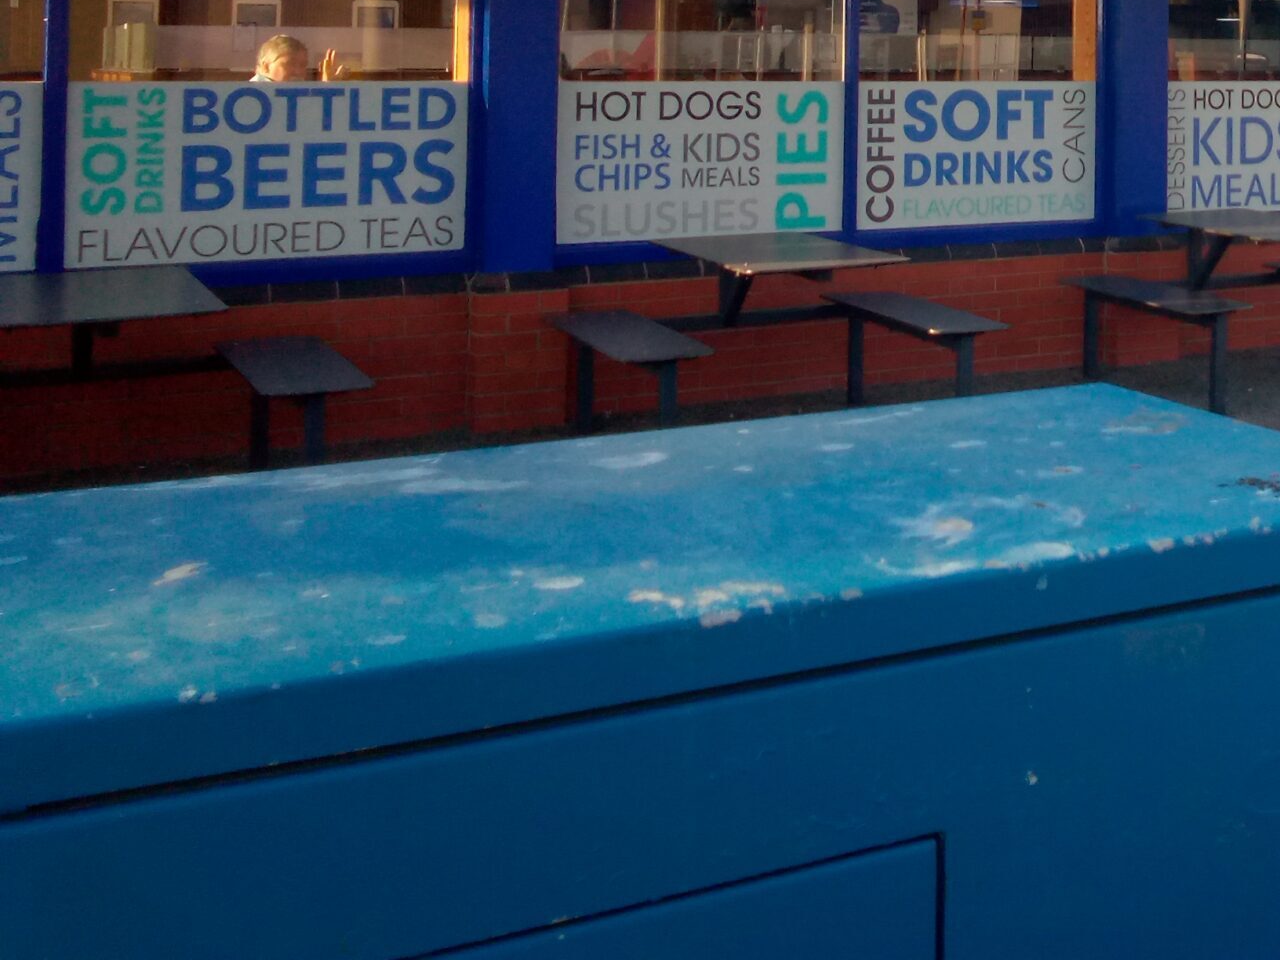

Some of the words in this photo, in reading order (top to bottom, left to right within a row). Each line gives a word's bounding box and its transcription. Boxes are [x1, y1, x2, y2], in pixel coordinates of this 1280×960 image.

[183, 87, 457, 134] BOTTLED
[575, 91, 647, 122] HOT
[659, 91, 762, 121] DOGS
[903, 88, 1054, 142] SOFT
[1193, 89, 1234, 111] HOT
[80, 87, 129, 216] SOFT
[134, 87, 167, 214] DRINKS
[575, 134, 641, 160] FISH
[650, 133, 672, 159] &
[683, 132, 761, 163] KIDS
[866, 88, 896, 223] COFFEE
[1062, 88, 1087, 183] CANS
[1167, 88, 1186, 210] DESSERTS
[181, 139, 456, 212] BEERS
[574, 163, 672, 192] CHIPS
[681, 166, 760, 189] MEALS
[775, 89, 829, 230] PIES
[904, 150, 1054, 187] DRINKS
[573, 197, 759, 239] SLUSHES
[902, 194, 1032, 220] FLAVOURED
[1037, 192, 1087, 215] TEAS
[78, 220, 346, 263] FLAVOURED
[360, 216, 454, 249] TEAS
